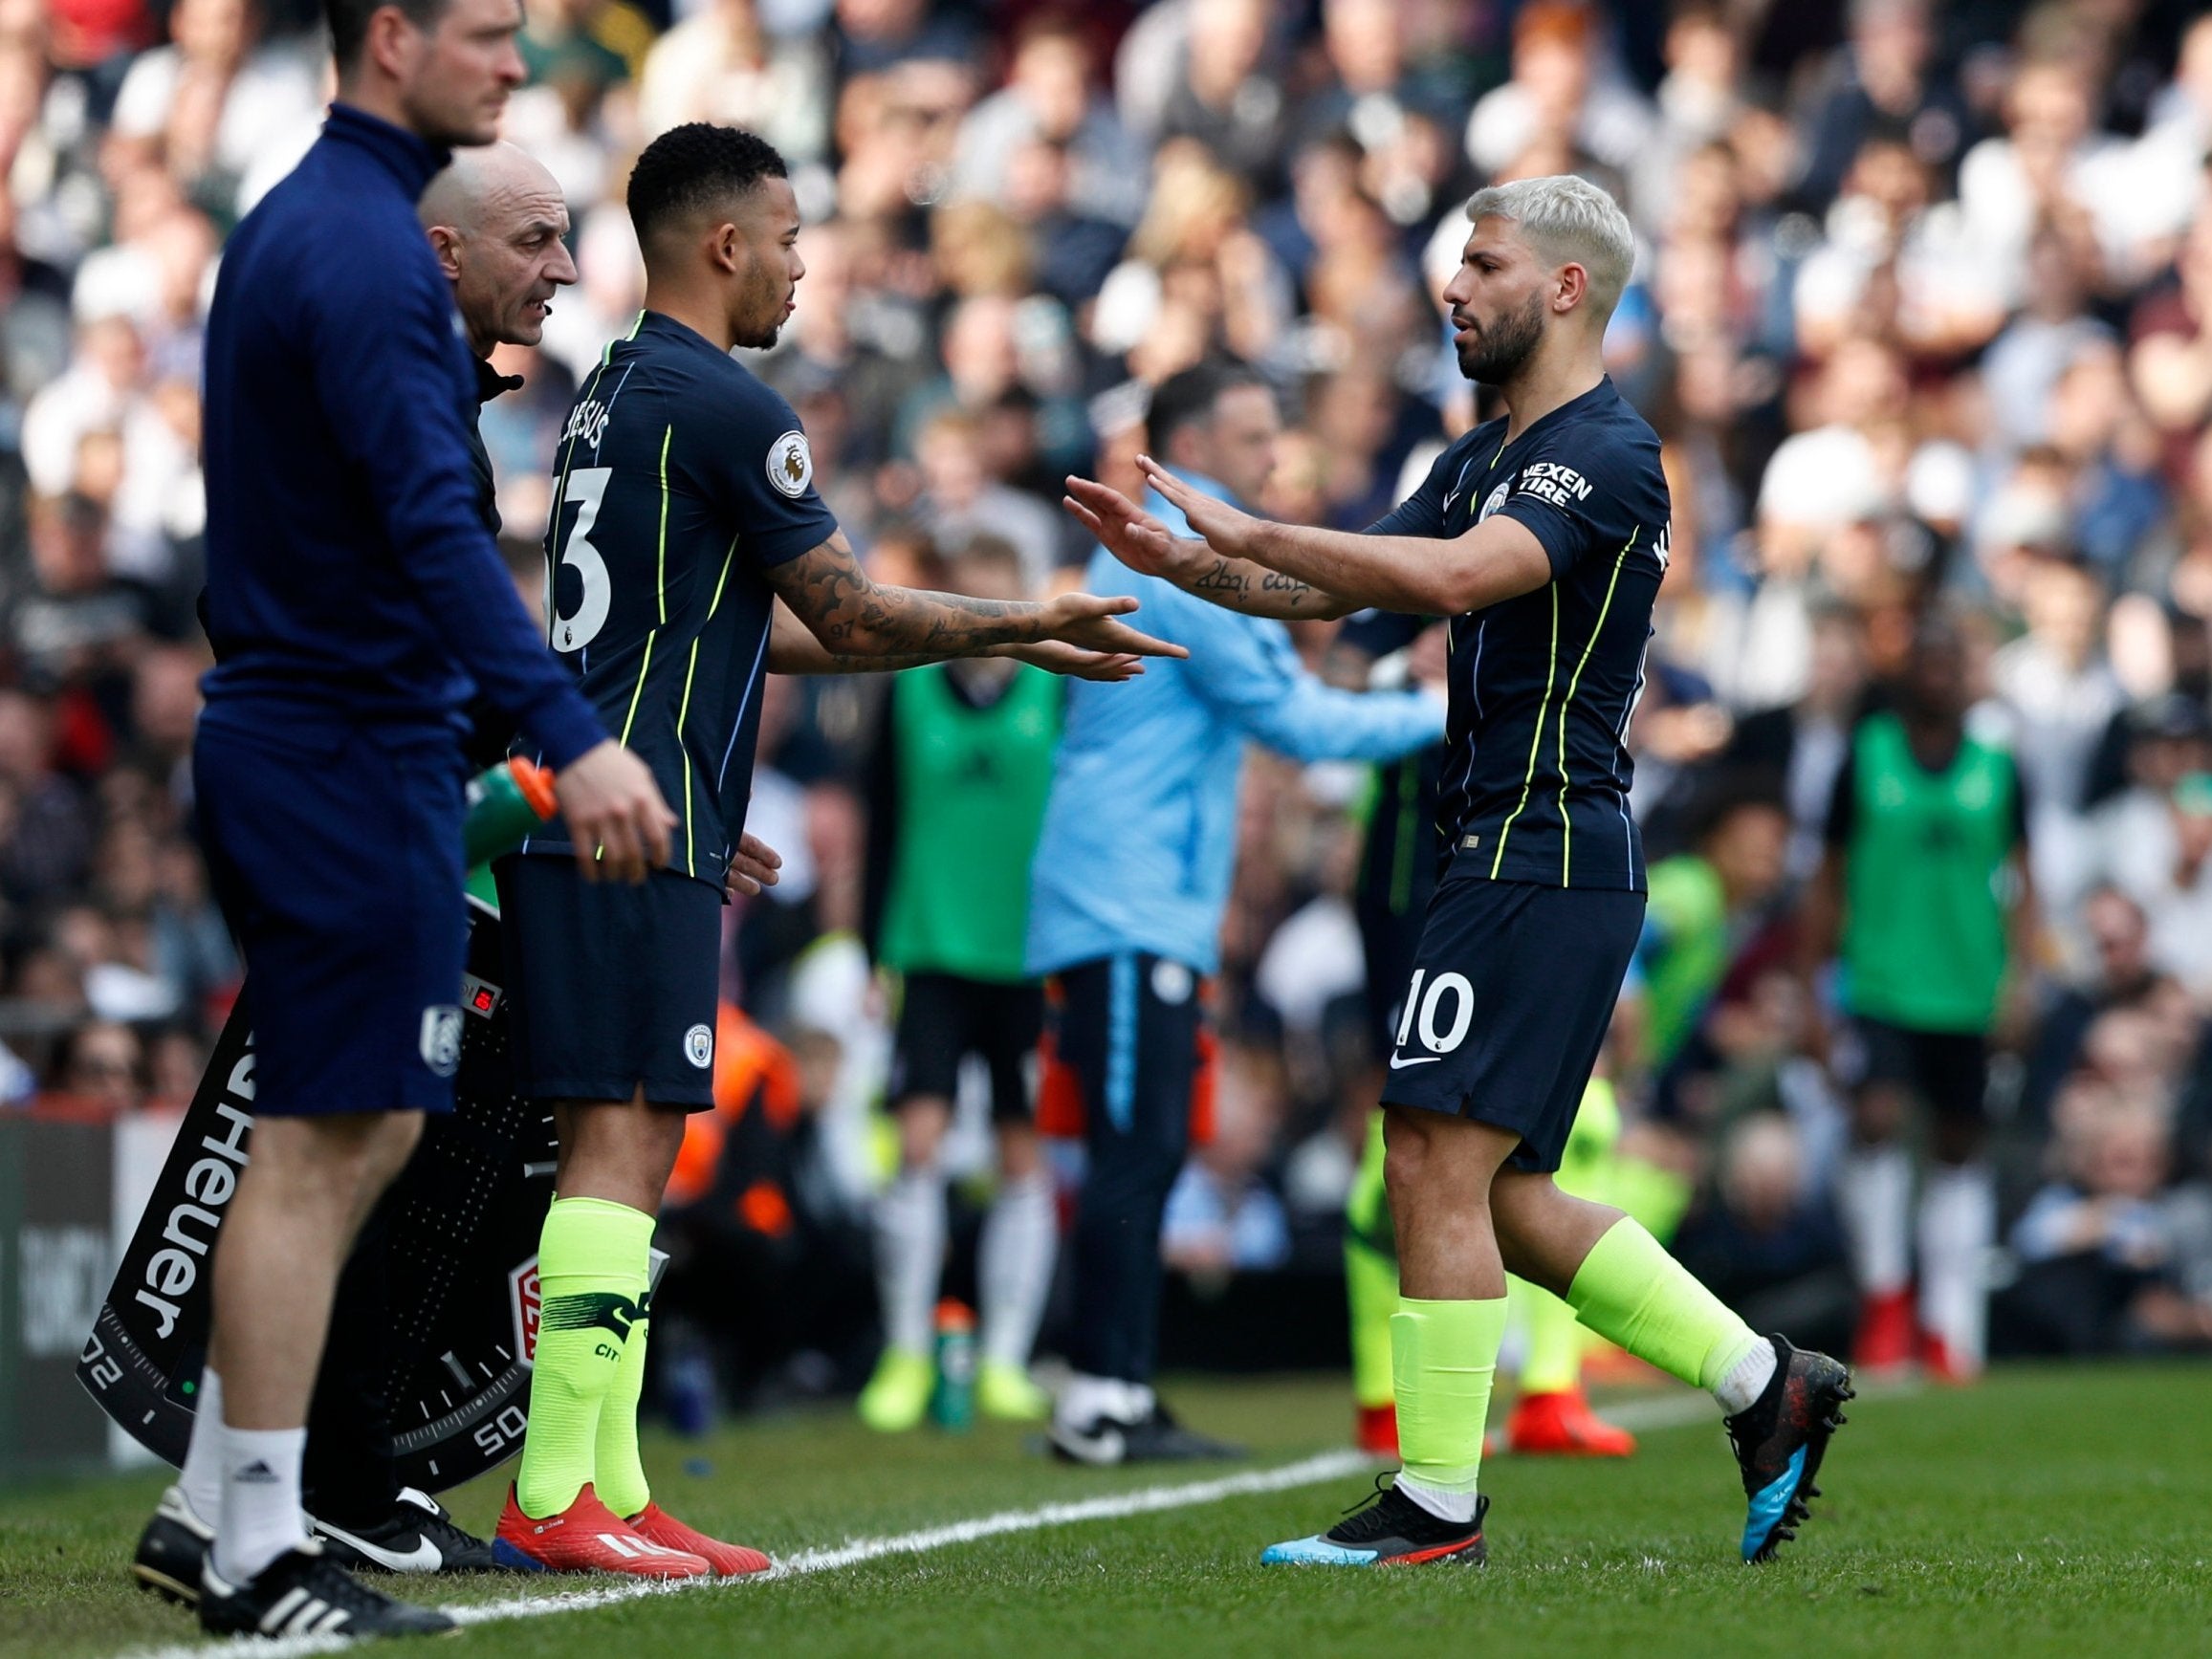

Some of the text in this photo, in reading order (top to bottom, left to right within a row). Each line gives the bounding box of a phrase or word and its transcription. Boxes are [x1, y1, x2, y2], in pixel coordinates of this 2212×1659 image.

[1519, 477, 1571, 508] TIRE
[543, 467, 613, 653] 3
[1396, 969, 1475, 1054] 10
